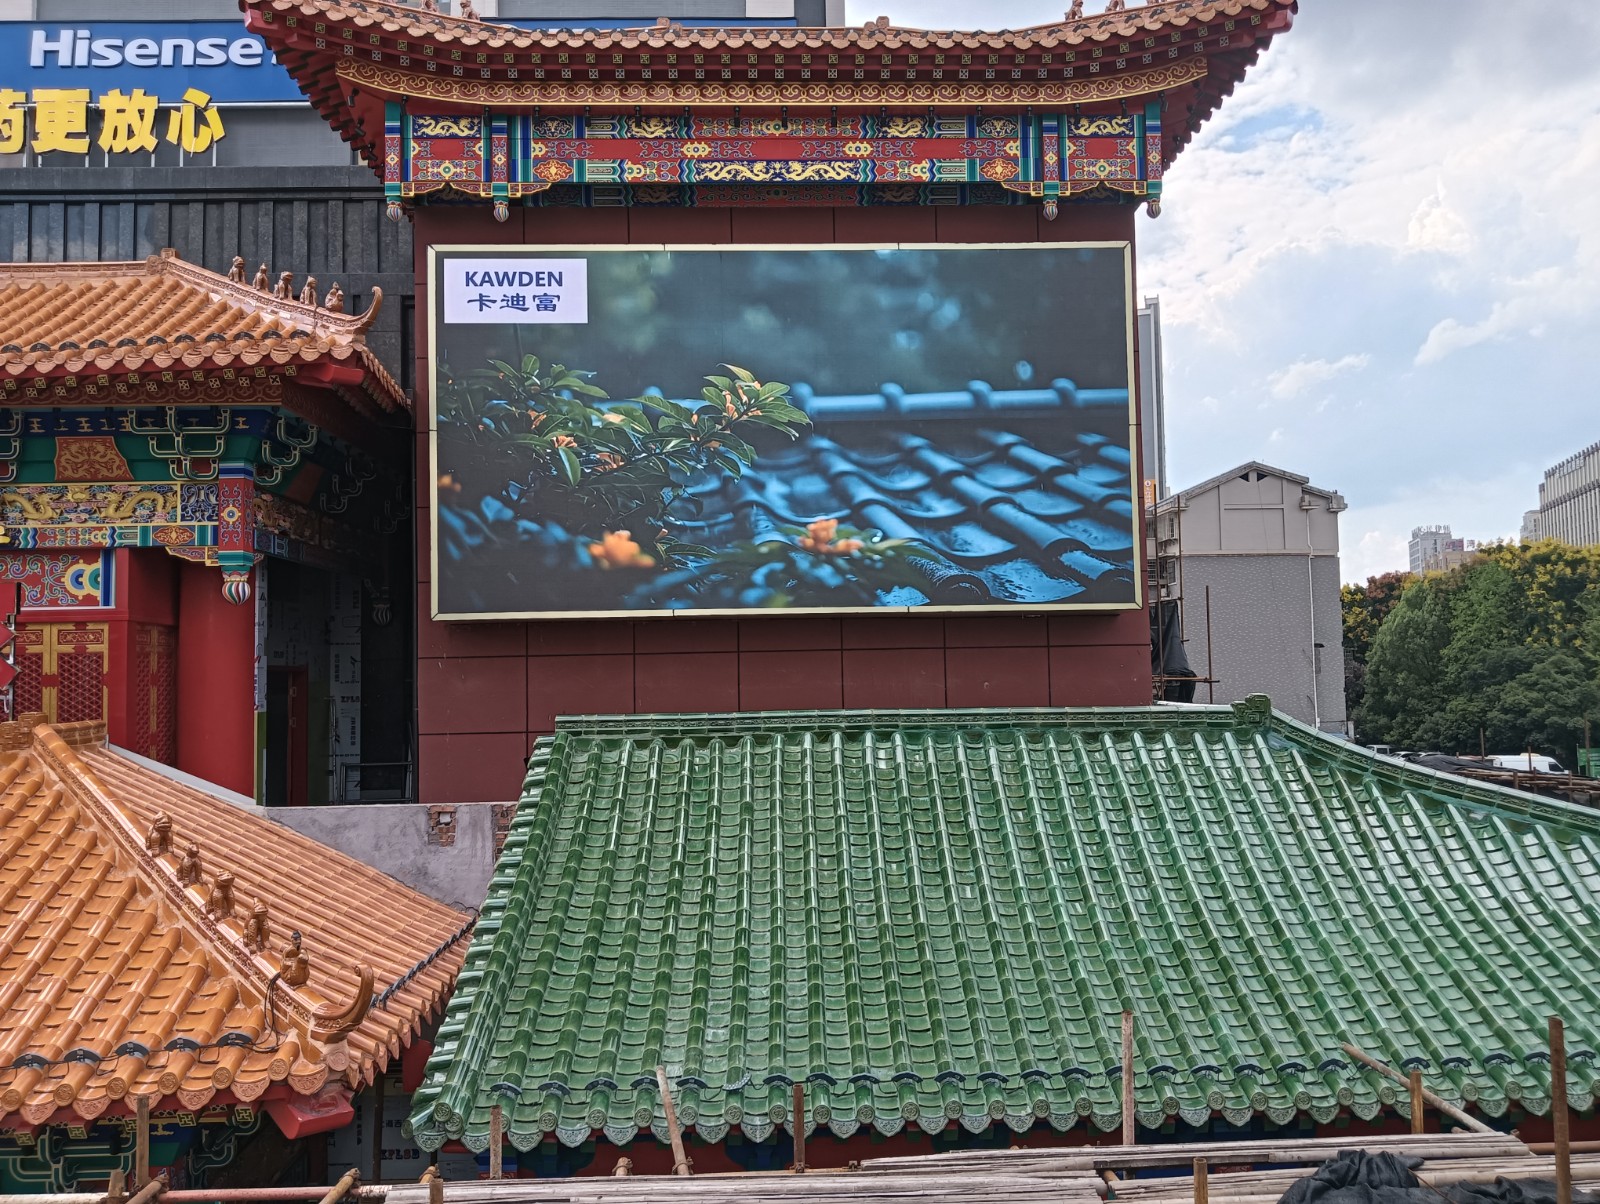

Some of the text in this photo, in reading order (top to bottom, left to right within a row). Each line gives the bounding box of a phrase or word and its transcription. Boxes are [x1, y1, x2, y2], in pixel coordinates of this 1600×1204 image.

[30, 29, 264, 68] Hisense
[465, 271, 563, 287] KAWDEN
[467, 293, 561, 313] 卡迪富
